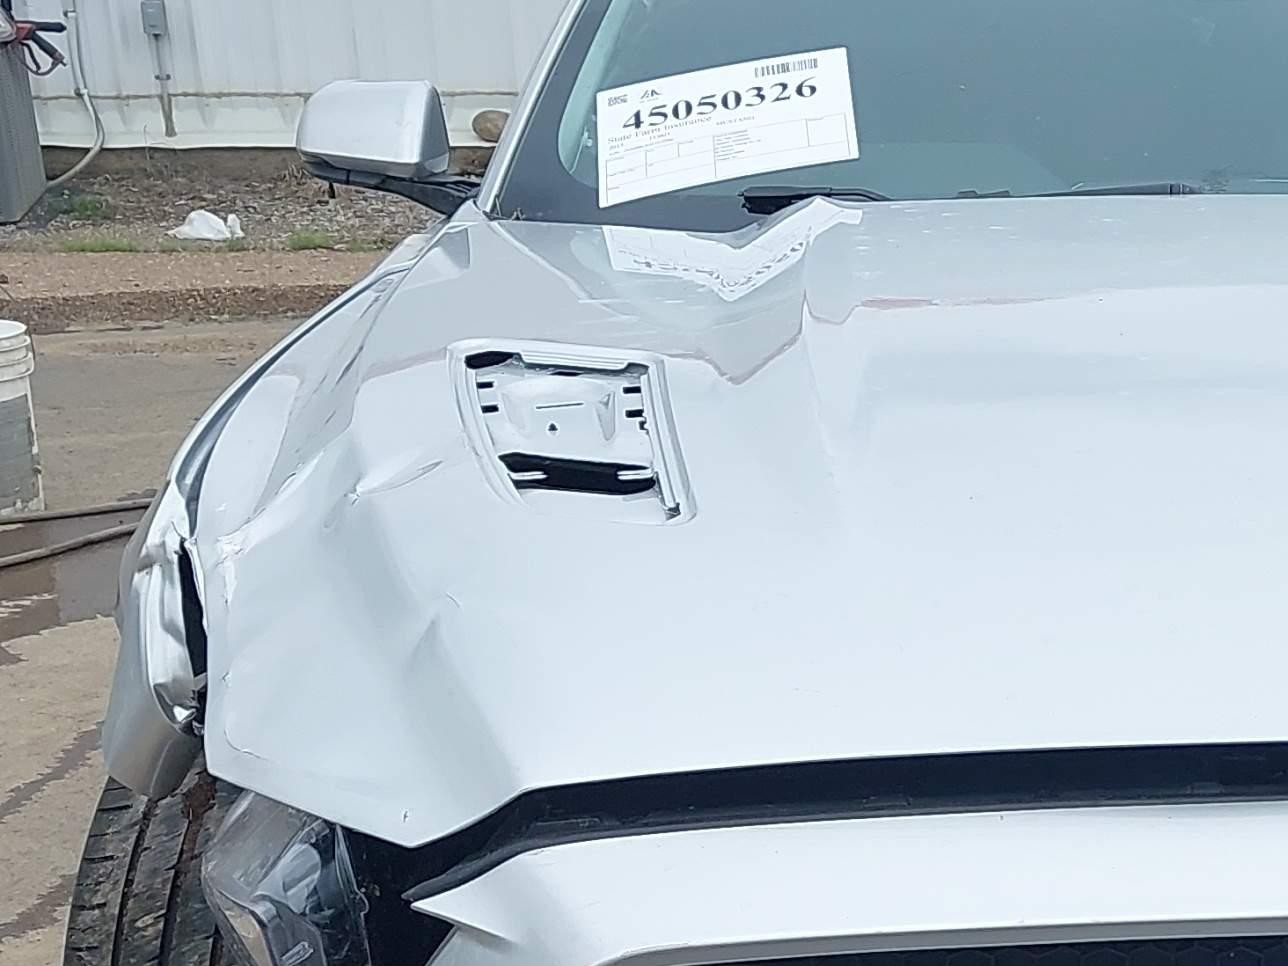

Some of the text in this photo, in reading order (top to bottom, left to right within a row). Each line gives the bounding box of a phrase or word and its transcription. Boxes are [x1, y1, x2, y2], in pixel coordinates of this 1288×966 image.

[622, 76, 817, 129] 45050326
[607, 133, 632, 143] State
[635, 127, 660, 137] Farm
[664, 115, 712, 131] Insurance
